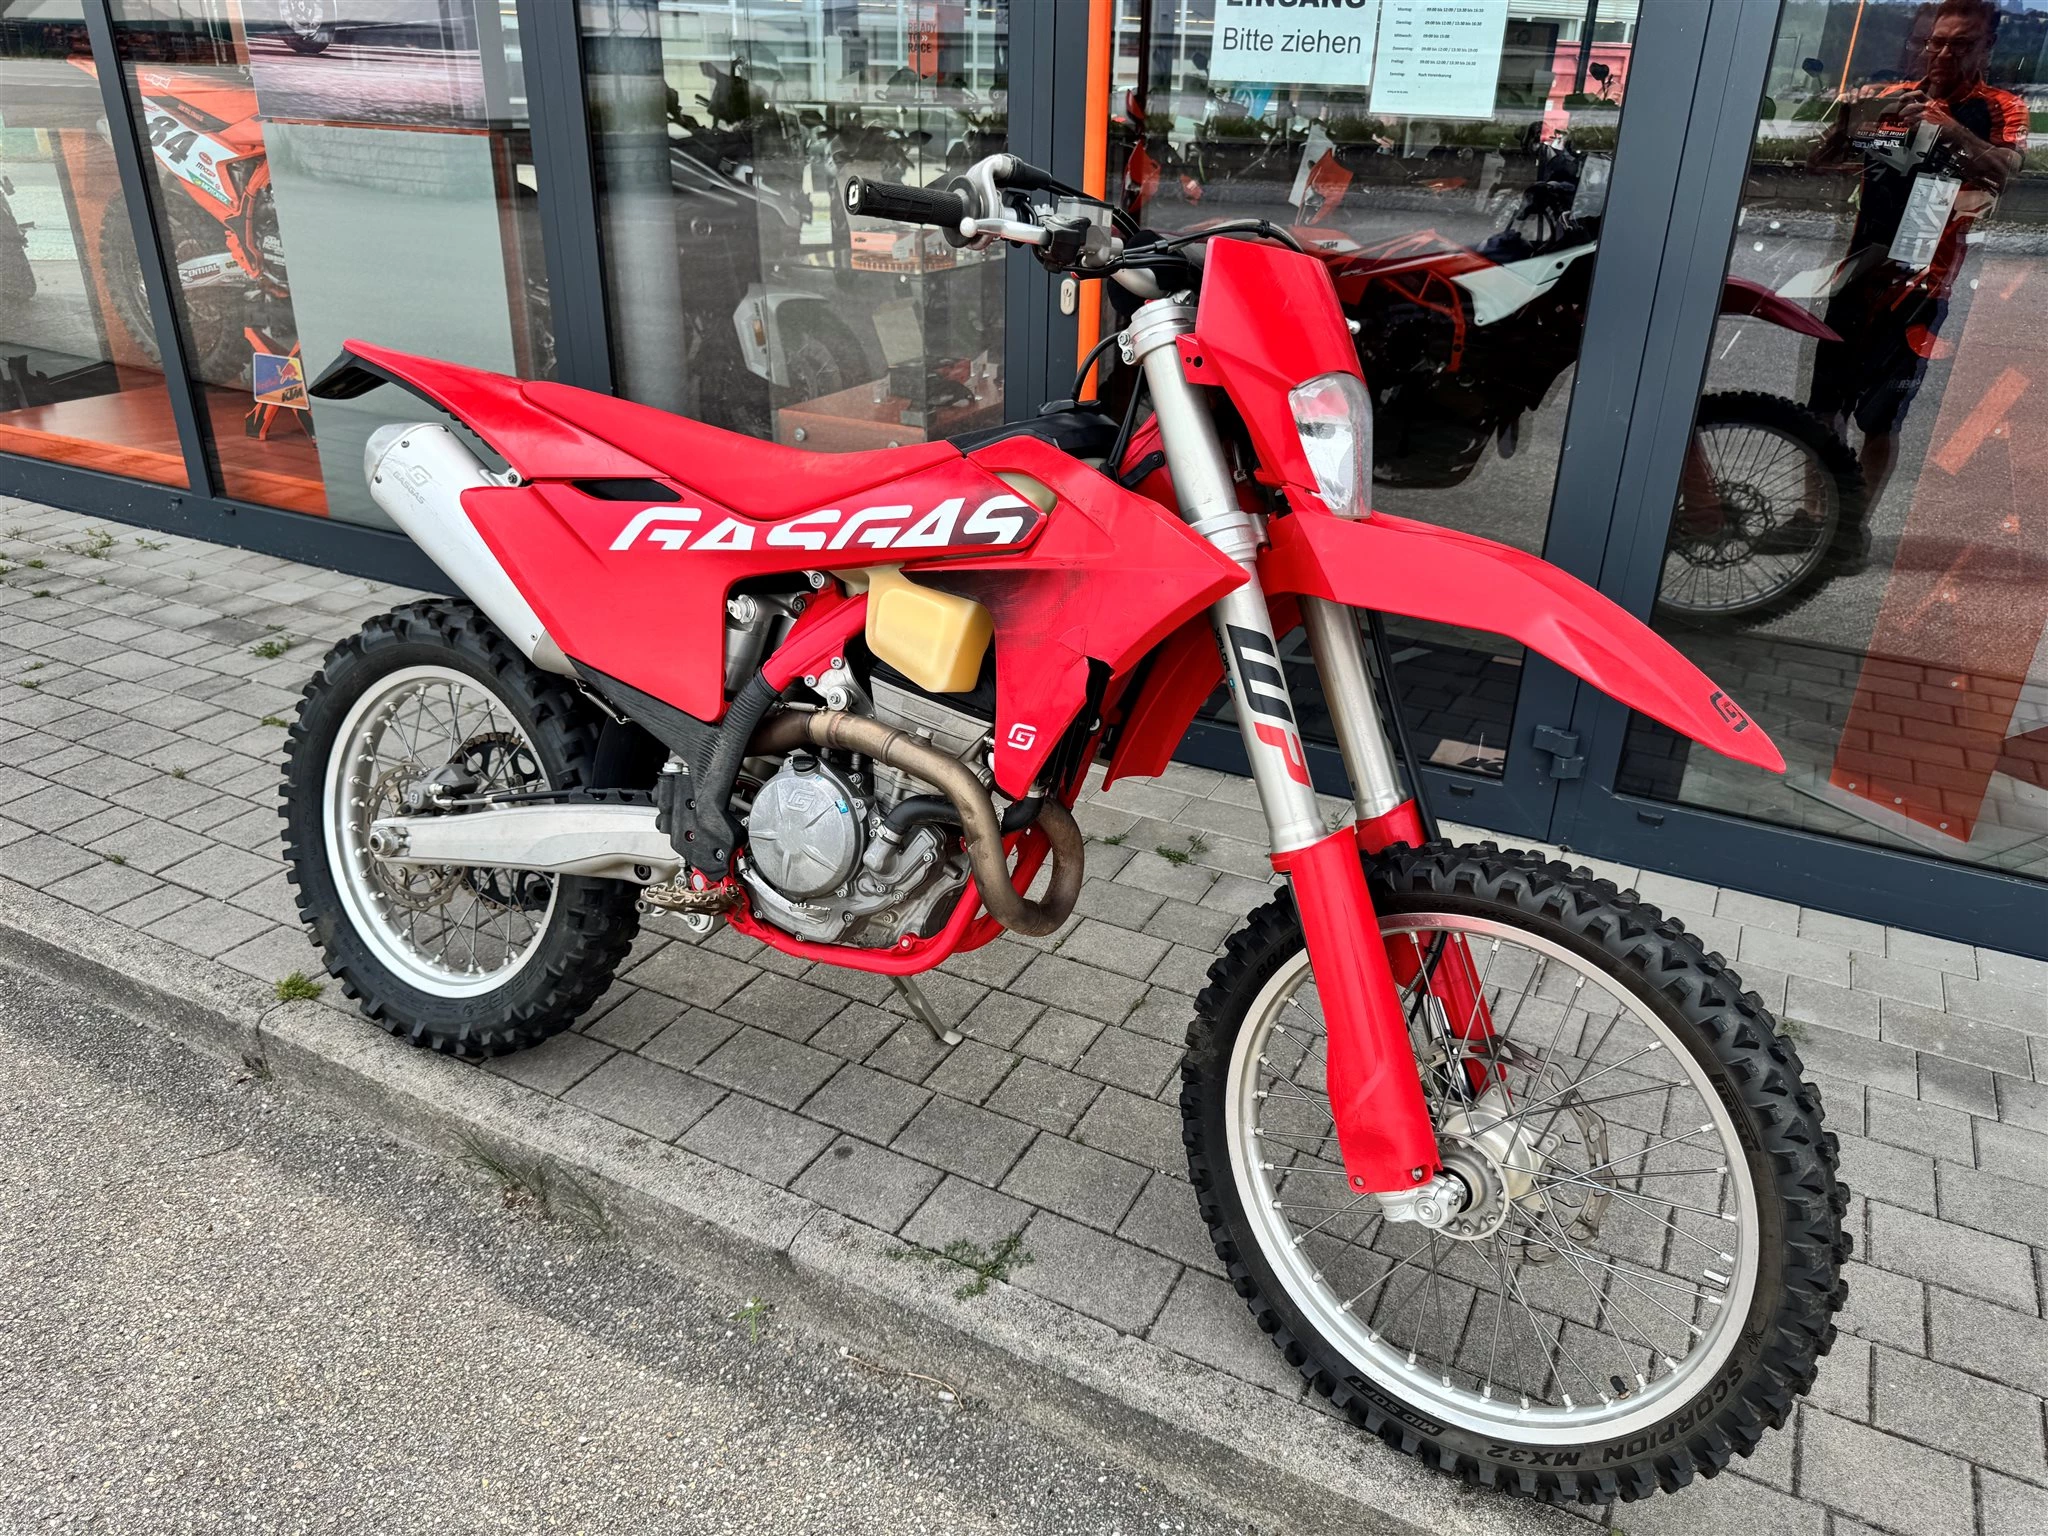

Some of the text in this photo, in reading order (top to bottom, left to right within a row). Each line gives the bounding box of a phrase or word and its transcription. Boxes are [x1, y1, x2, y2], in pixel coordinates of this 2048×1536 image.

[1223, 27, 1361, 54] Bitte ziehen
[148, 115, 199, 165] 84
[609, 494, 1031, 551] GASGAS
[1350, 1379, 1438, 1435] MID SOFT
[1486, 1358, 1744, 1467] SCORPION MX32
